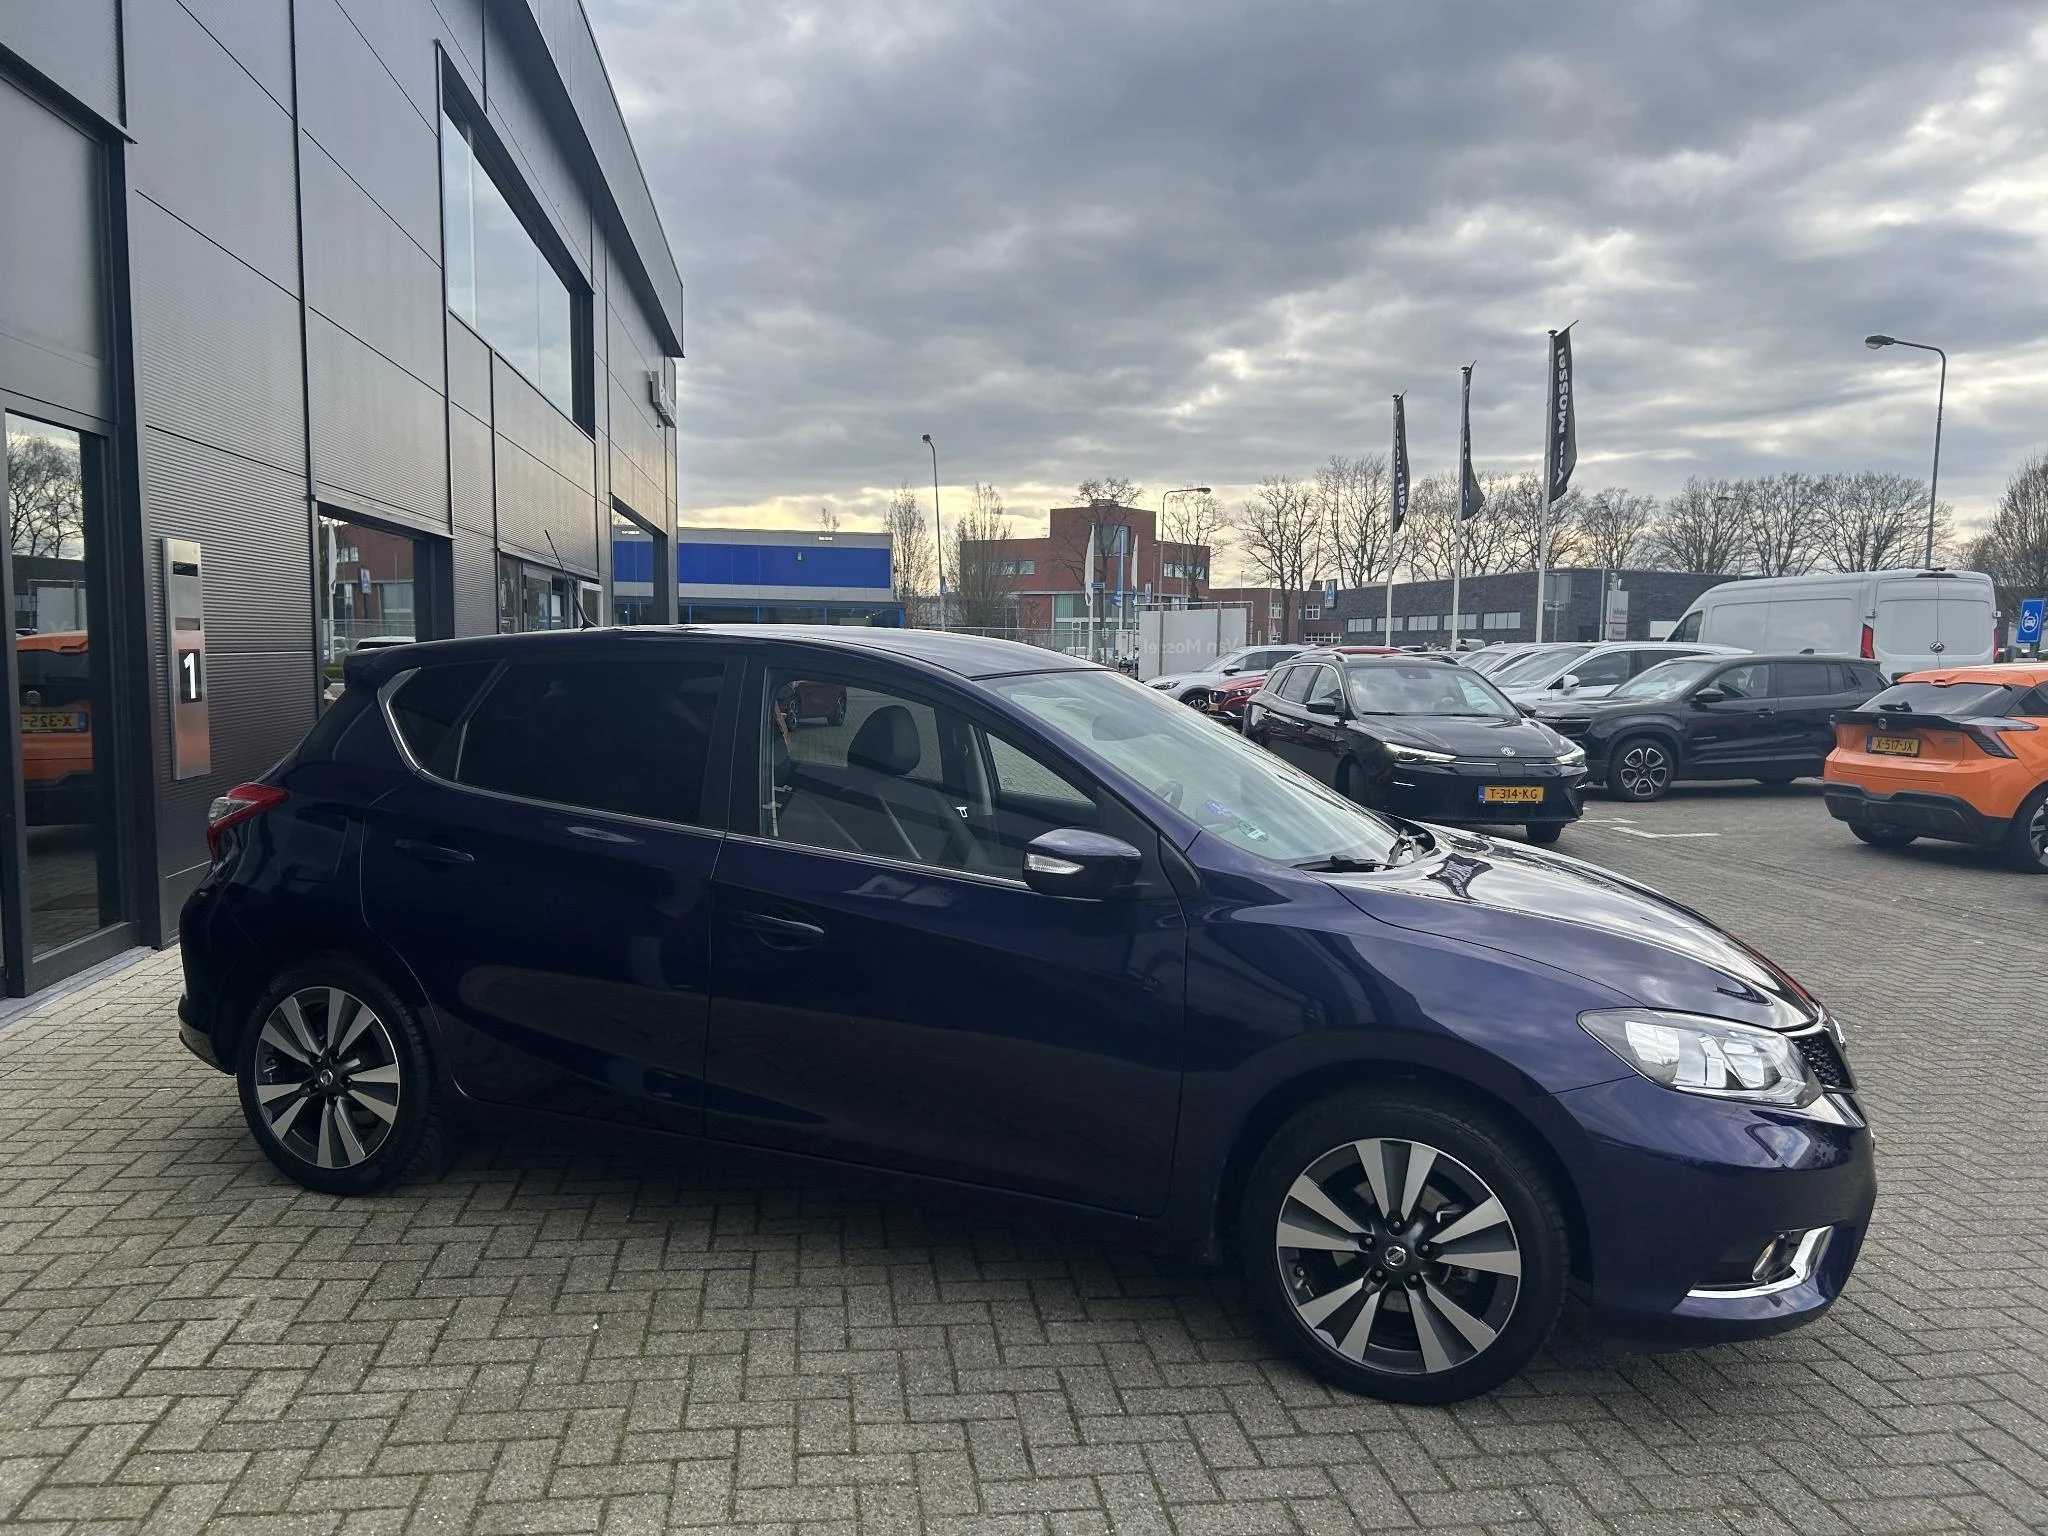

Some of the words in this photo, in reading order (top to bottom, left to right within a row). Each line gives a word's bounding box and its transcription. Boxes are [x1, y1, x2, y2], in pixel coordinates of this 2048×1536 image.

[1557, 347, 1569, 434] Mossel
[183, 652, 197, 699] 1
[1876, 738, 1913, 752] X-517-JX
[1489, 788, 1538, 800] T-314-KG
